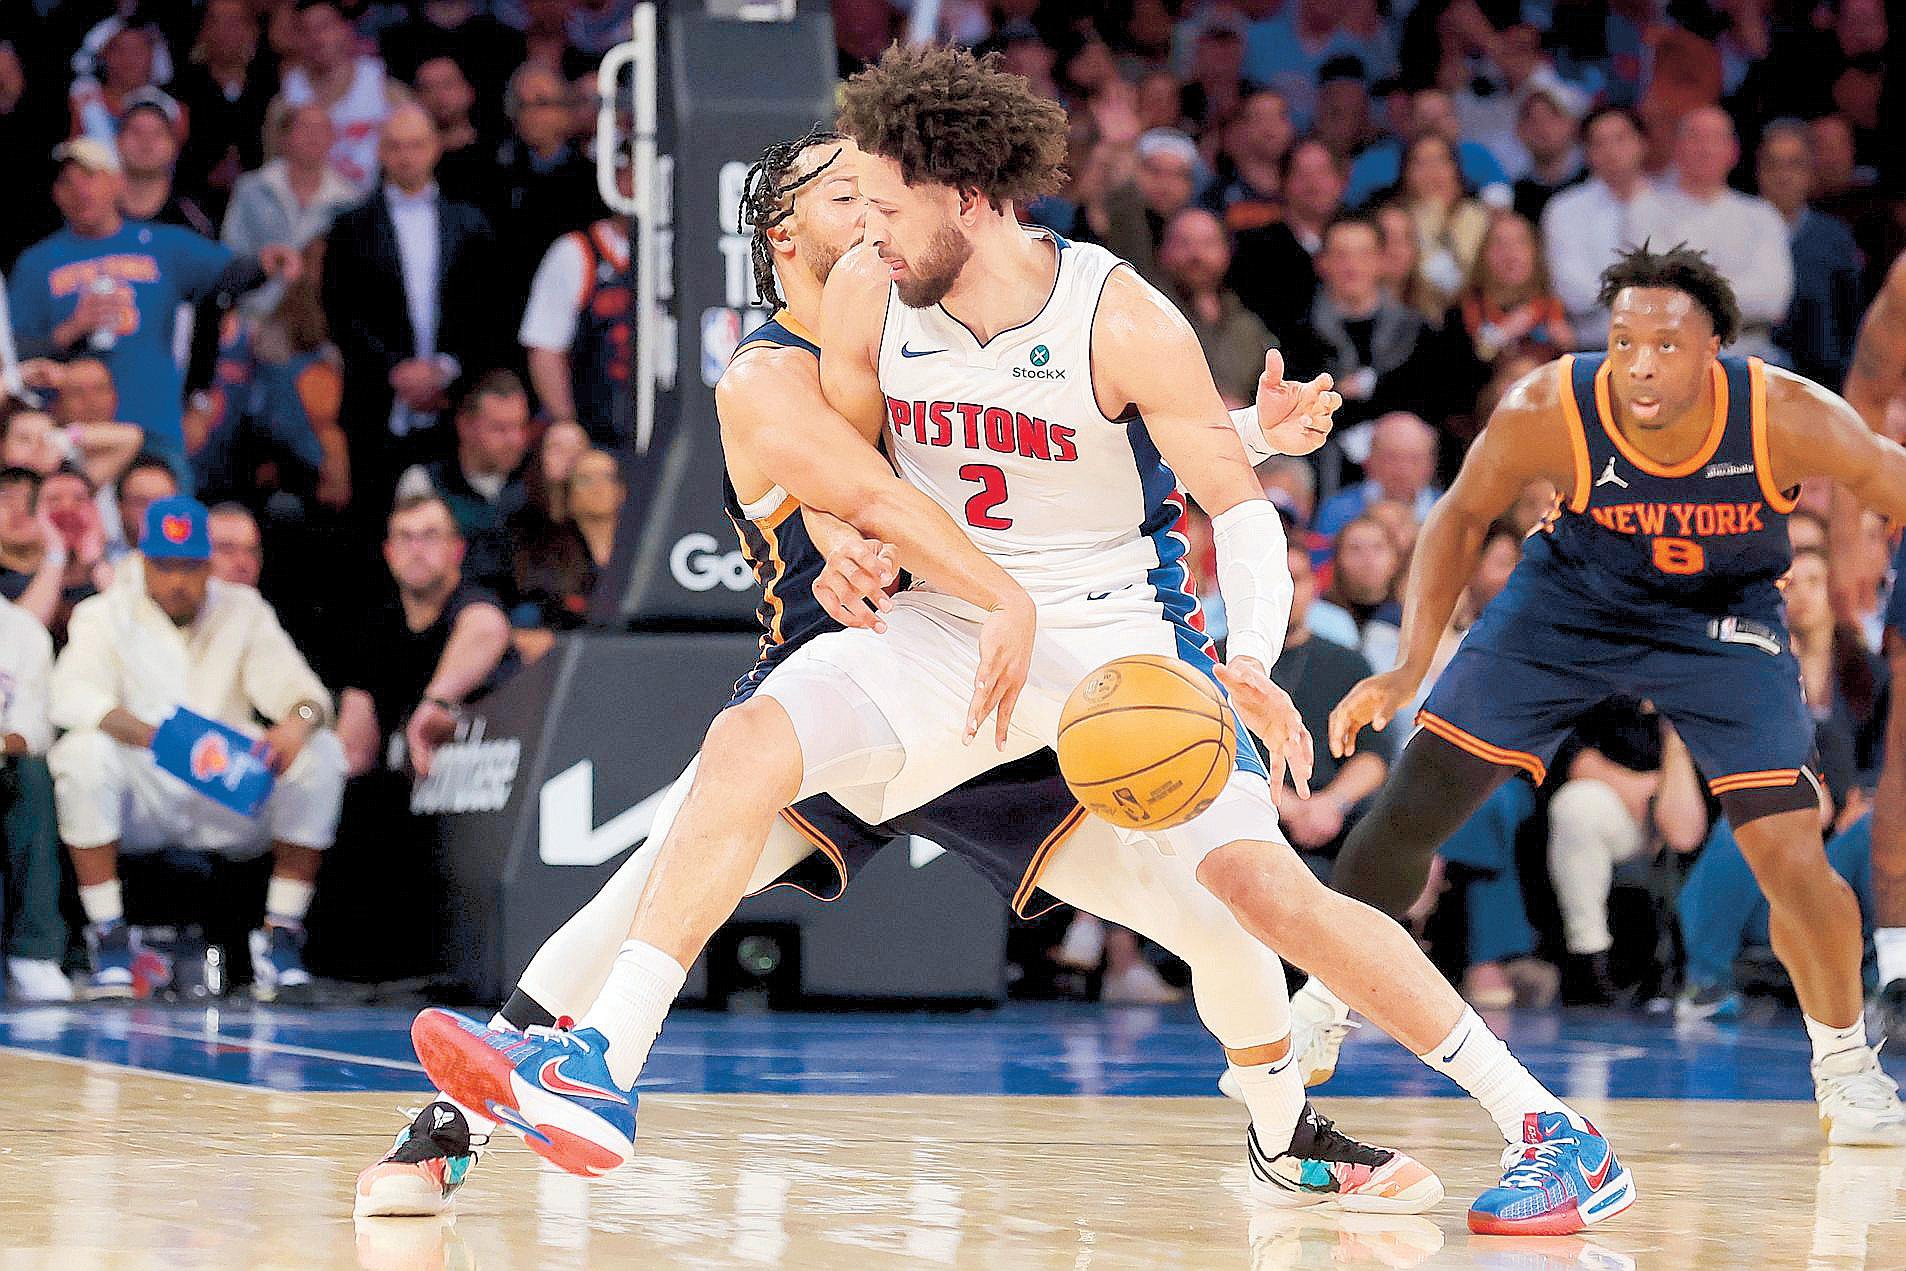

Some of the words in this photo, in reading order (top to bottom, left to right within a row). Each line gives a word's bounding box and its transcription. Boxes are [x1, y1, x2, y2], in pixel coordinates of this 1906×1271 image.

[1012, 367, 1066, 380] StockX
[887, 395, 1079, 462] PISTONS
[958, 463, 1014, 531] 2
[1590, 502, 1667, 536] NEW
[1670, 502, 1764, 537] YORK
[1651, 536, 1706, 575] 8
